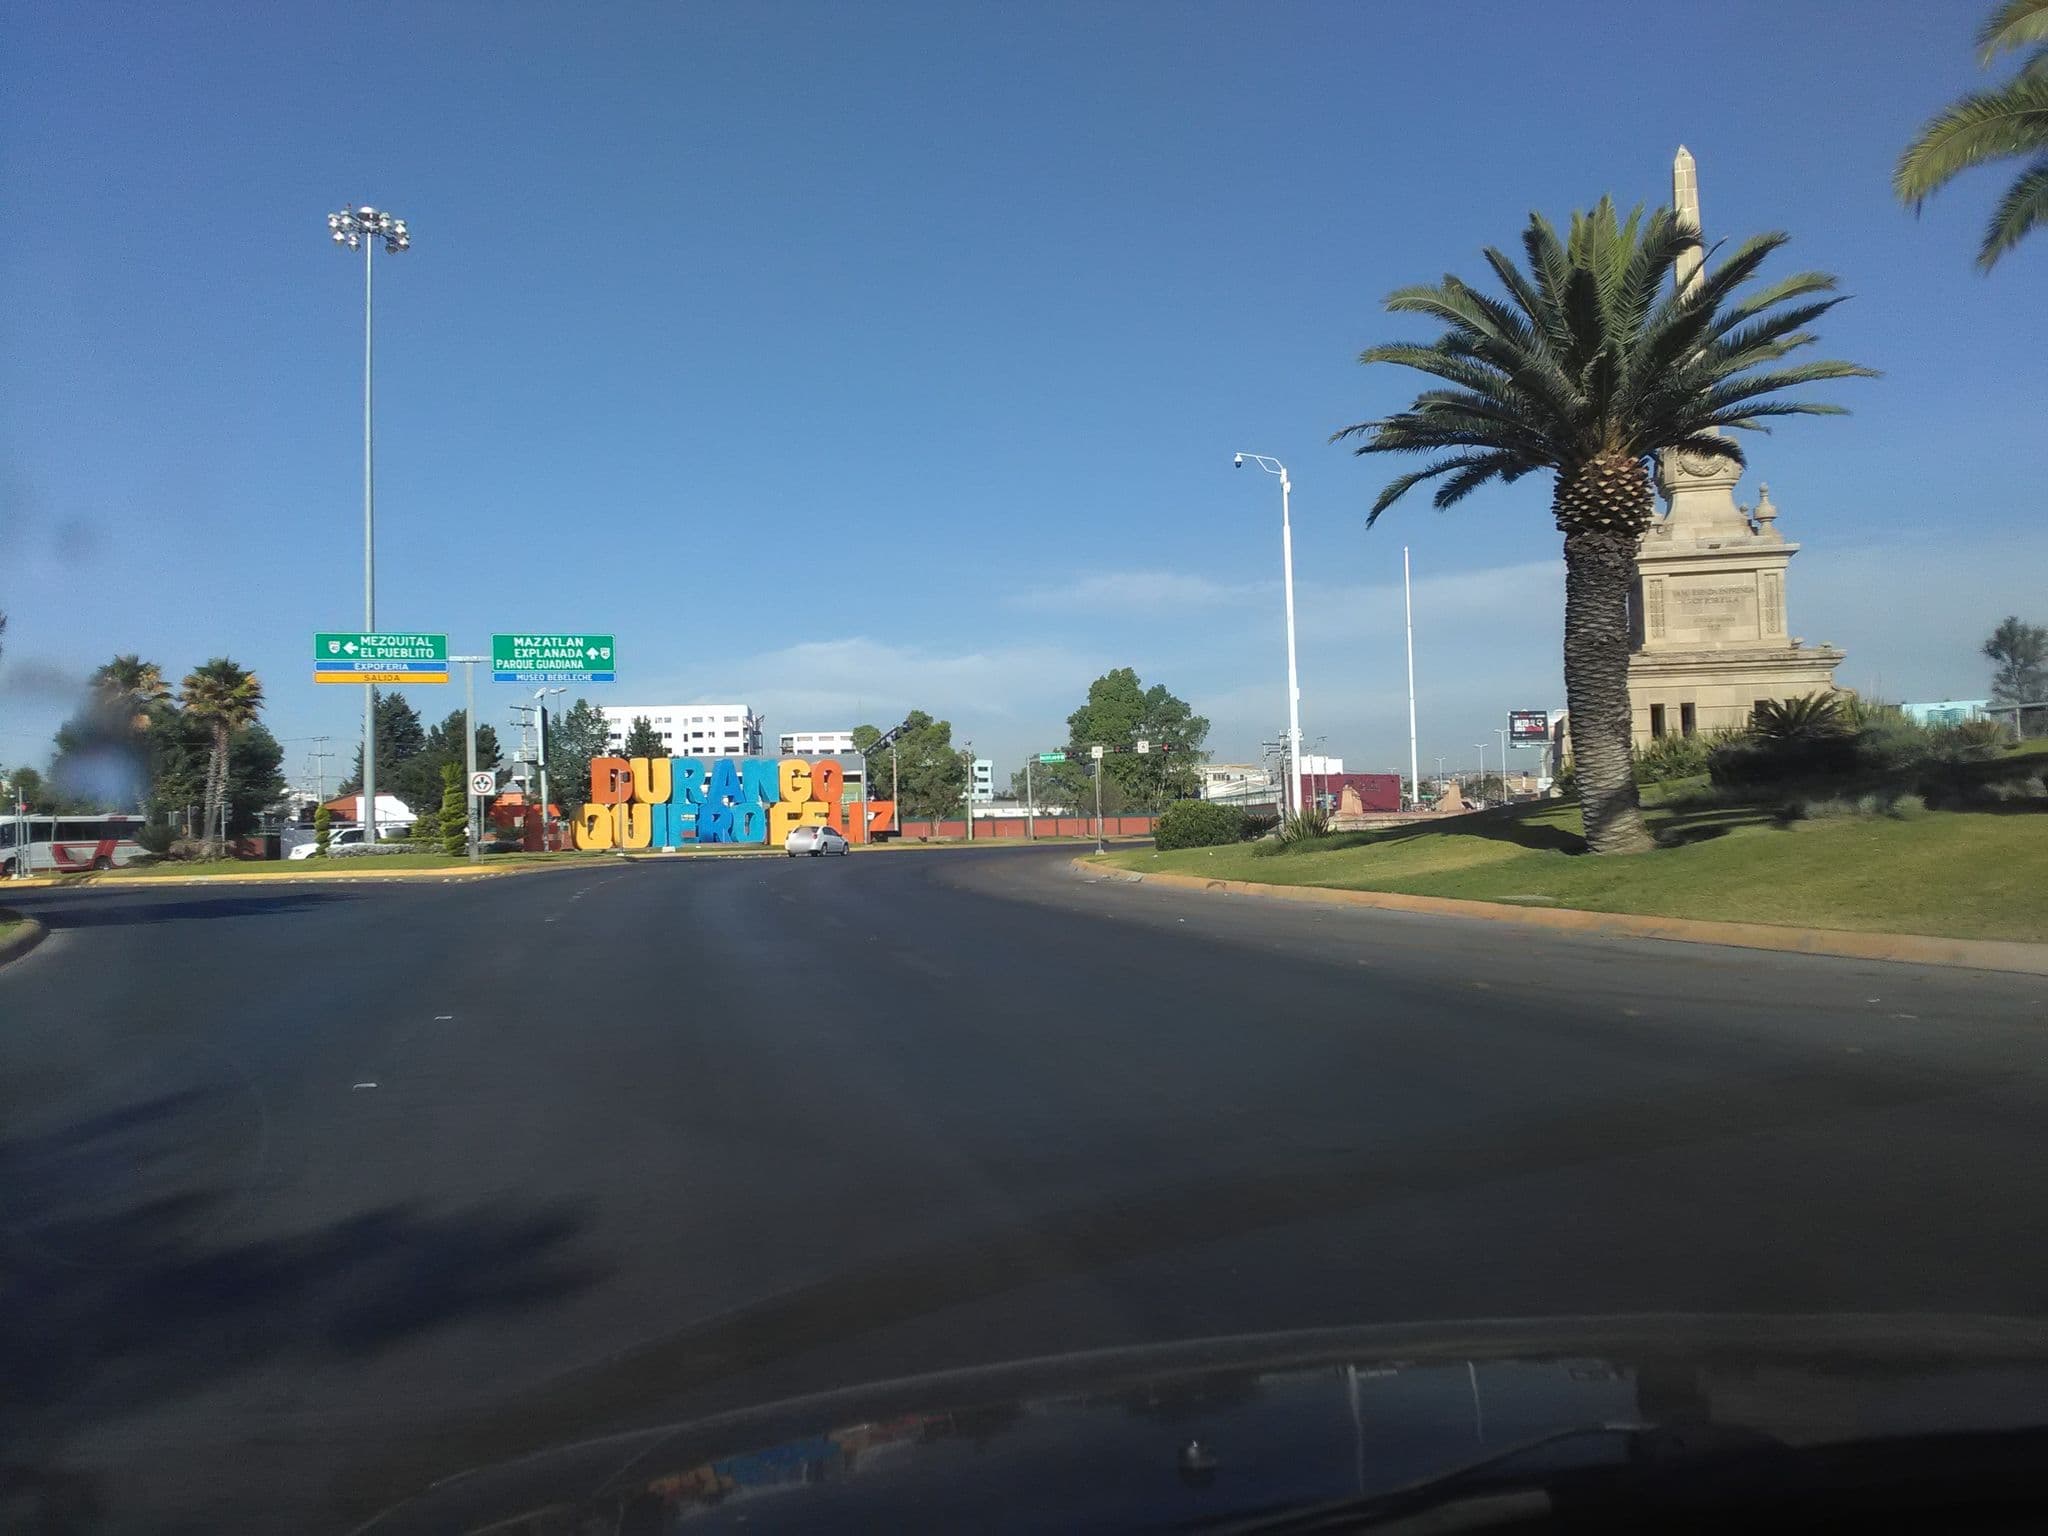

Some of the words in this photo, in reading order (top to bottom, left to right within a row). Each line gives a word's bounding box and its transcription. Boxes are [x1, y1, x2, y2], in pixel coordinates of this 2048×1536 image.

[360, 636, 434, 647] MEZQUITAL
[513, 637, 584, 647] MAZATLAN
[360, 648, 376, 658] EL
[377, 648, 435, 659] PUEBLITO
[514, 648, 584, 658] EXPLANADA
[354, 663, 409, 671] EXPOFERIA
[496, 659, 535, 669] PARQUE
[536, 659, 585, 669] GUADIANA
[363, 674, 401, 682] SALIDA
[591, 757, 844, 804] DURANGO
[572, 801, 767, 850] QUIERO
